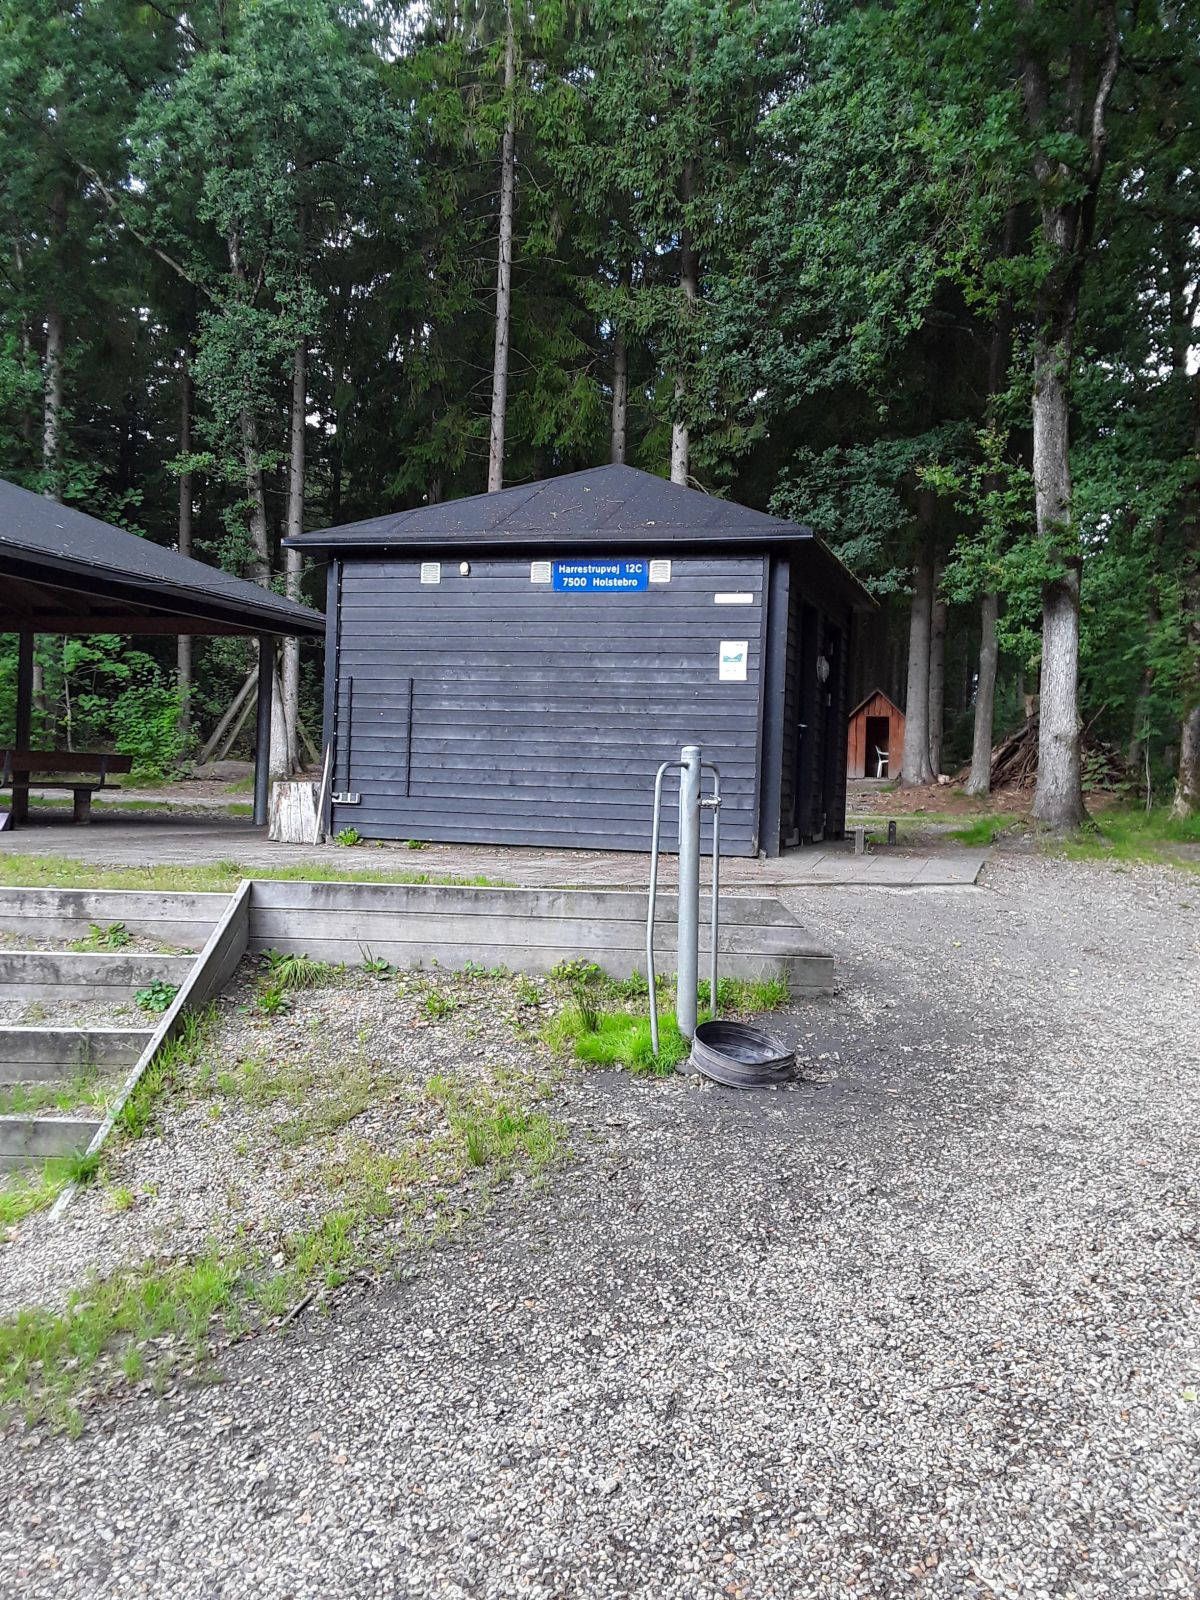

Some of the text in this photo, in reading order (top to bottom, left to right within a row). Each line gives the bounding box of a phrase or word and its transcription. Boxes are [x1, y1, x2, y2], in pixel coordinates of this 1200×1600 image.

[558, 564, 642, 575] Harrestrupvej 12C
[562, 577, 638, 586] 7500 Holstebro
